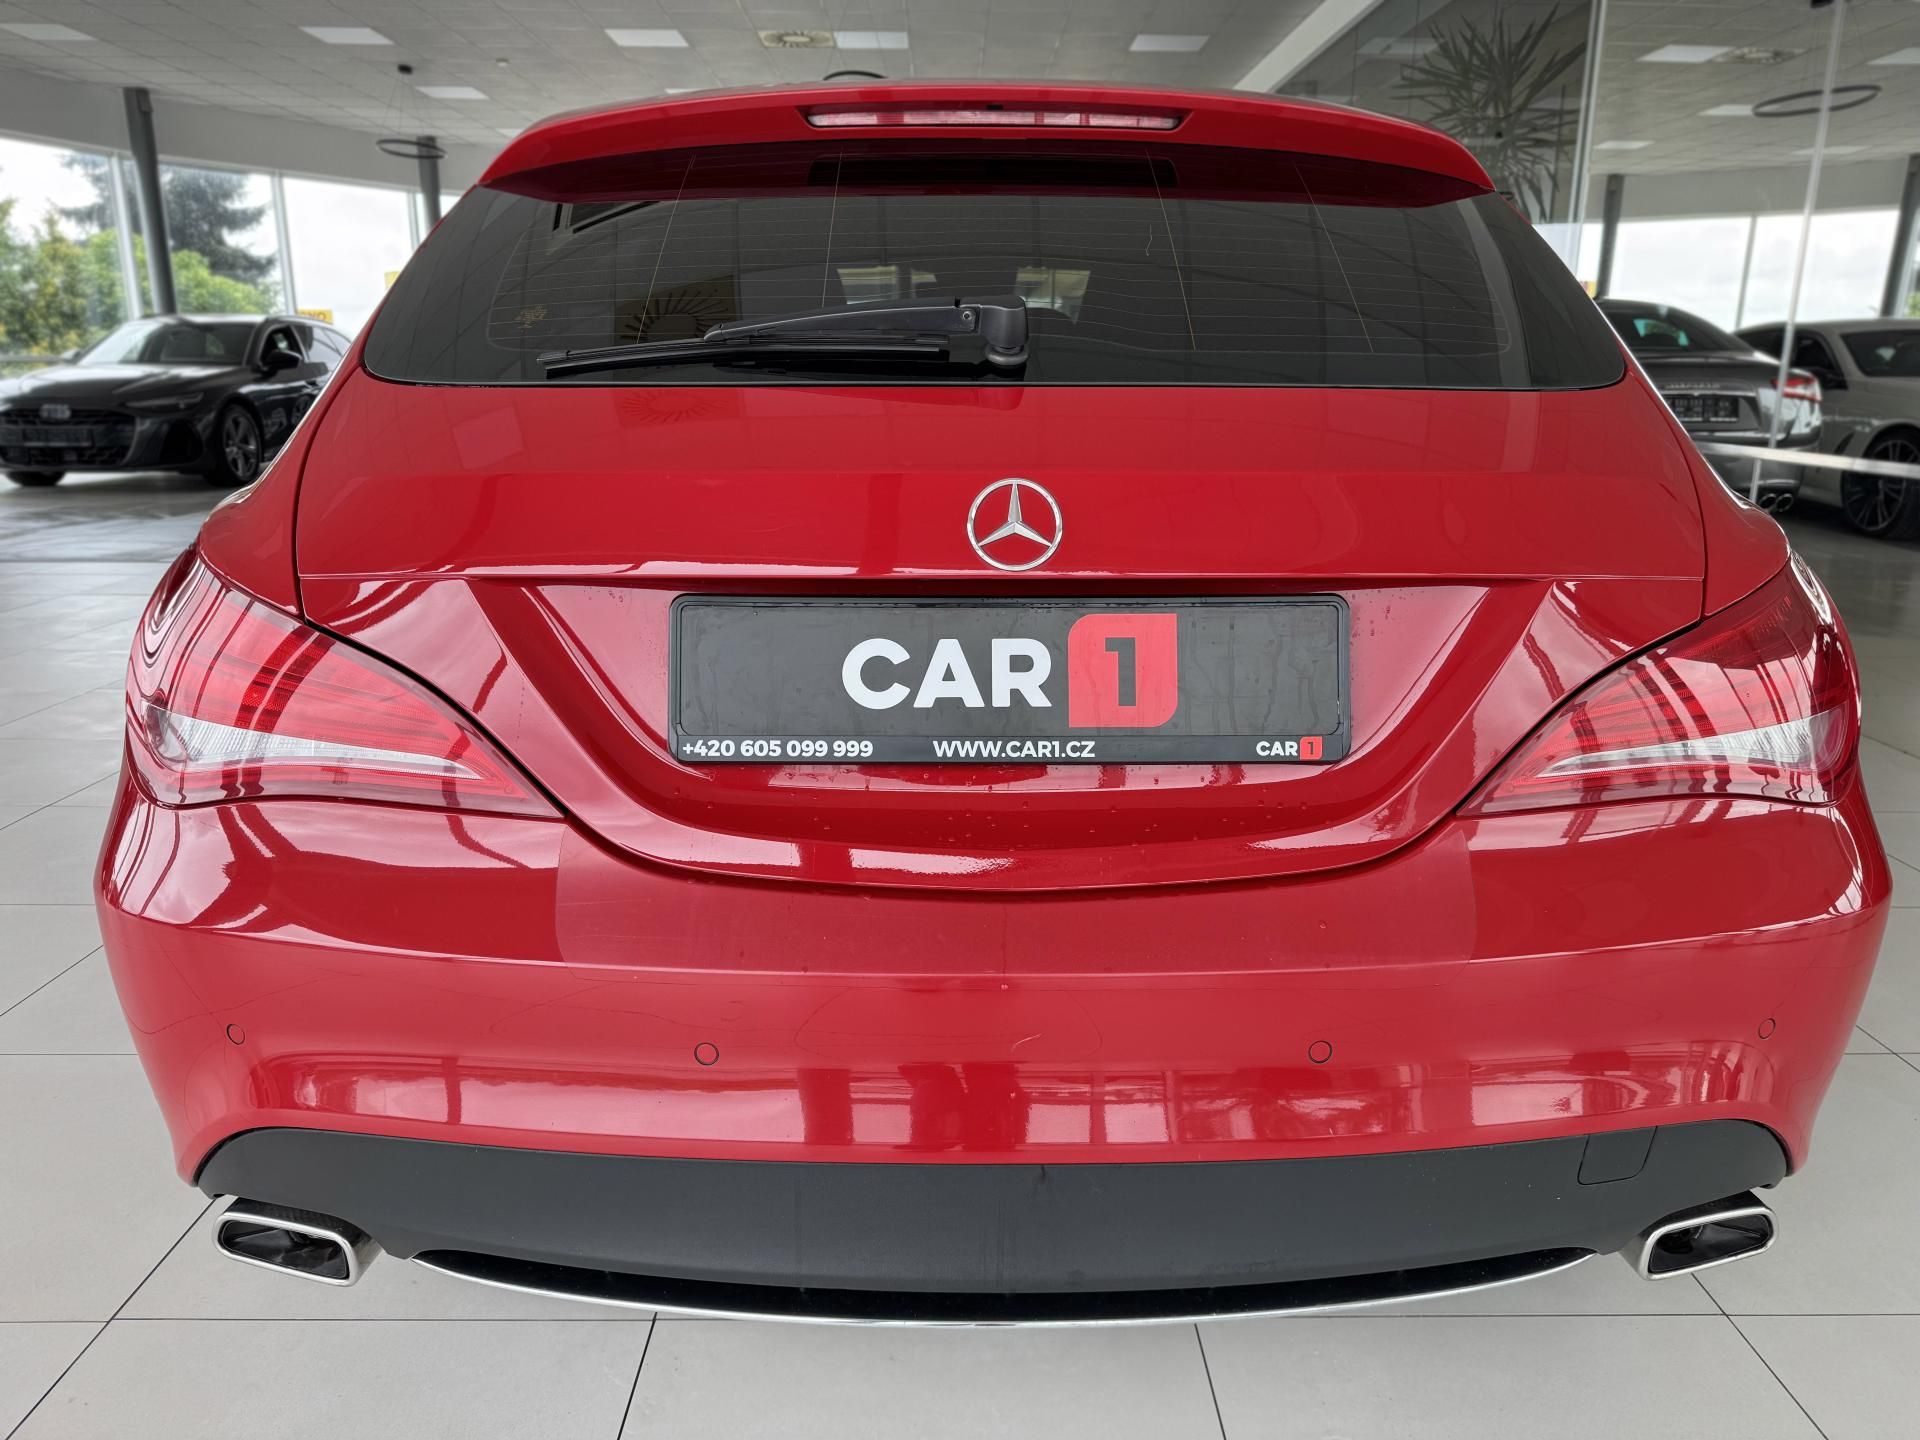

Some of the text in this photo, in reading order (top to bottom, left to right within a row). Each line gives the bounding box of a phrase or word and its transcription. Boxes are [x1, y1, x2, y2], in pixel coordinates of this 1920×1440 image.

[841, 637, 1053, 710] CAR
[682, 739, 874, 758] +420 605 099 999
[932, 740, 1096, 758] WWW.CAR1.CZ
[1255, 740, 1299, 757] CAR
